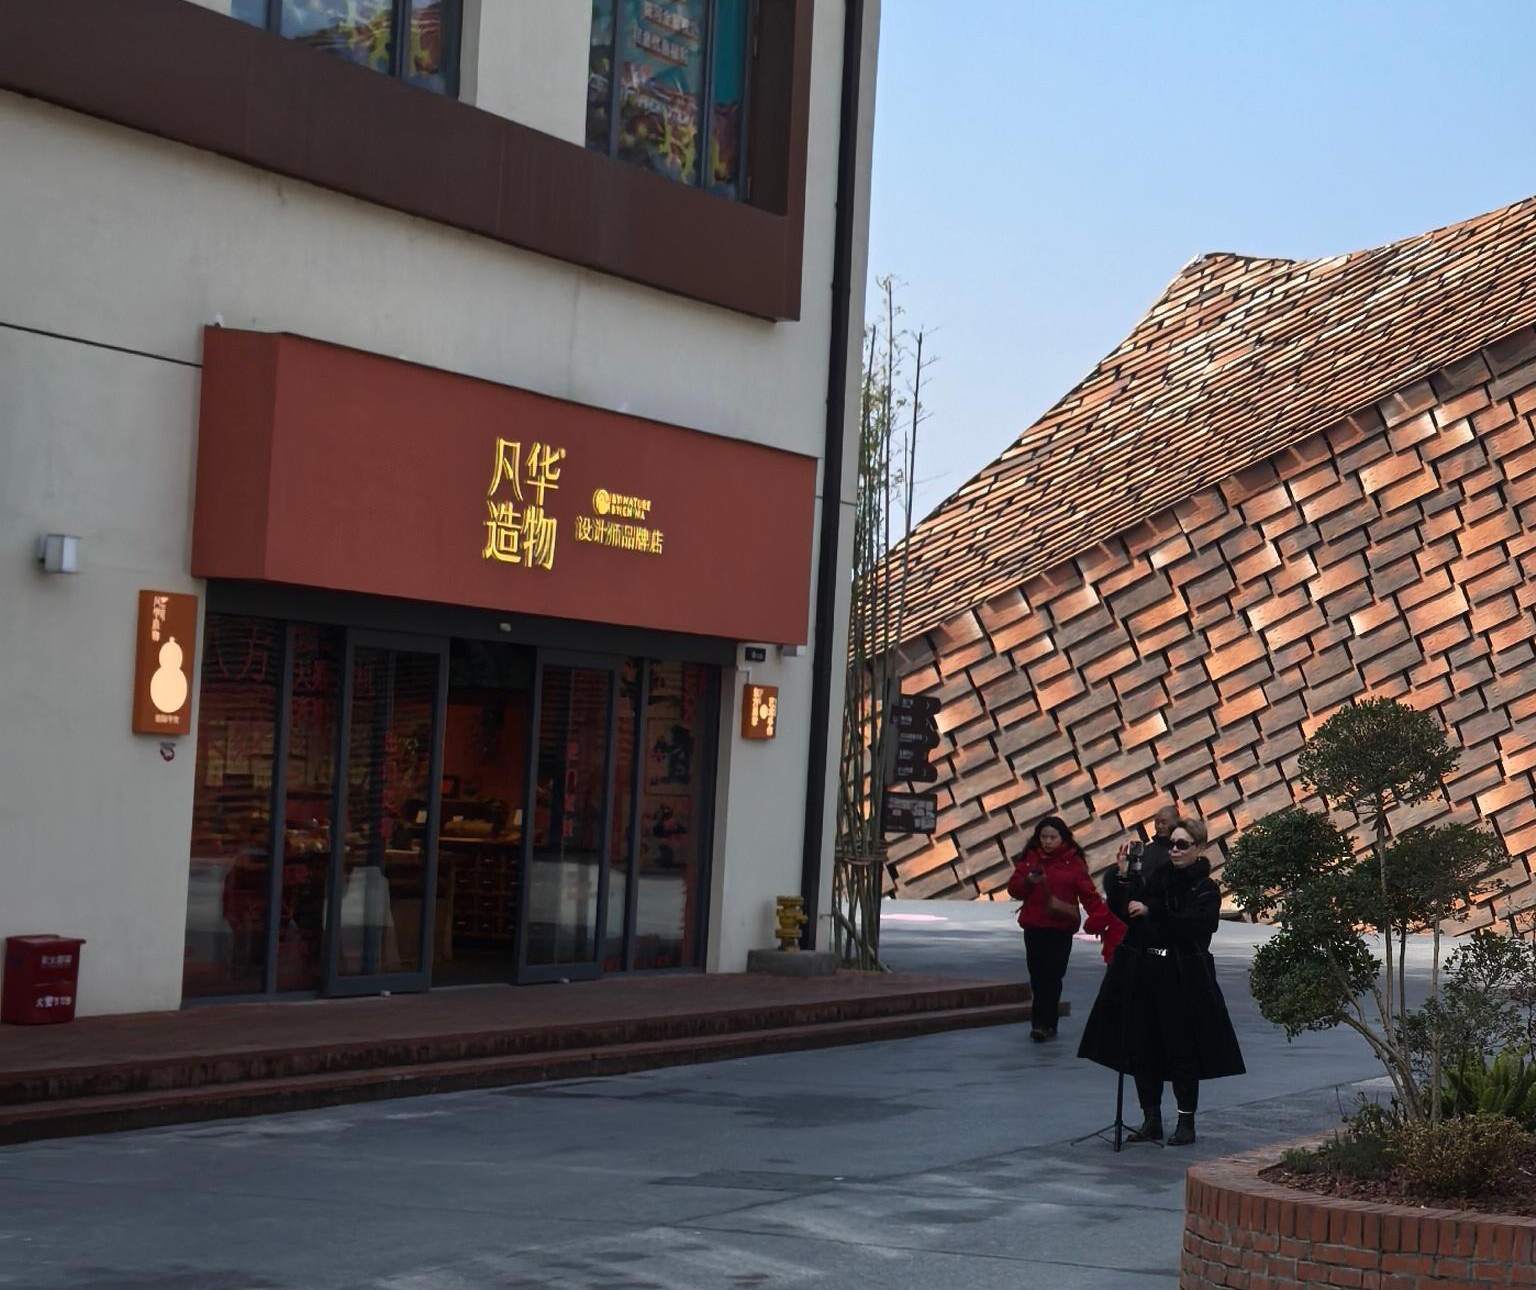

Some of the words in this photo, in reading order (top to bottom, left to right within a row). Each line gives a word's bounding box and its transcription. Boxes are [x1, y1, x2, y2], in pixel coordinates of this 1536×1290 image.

[482, 500, 557, 570] 造物
[576, 515, 664, 555] 设计师品牌店
